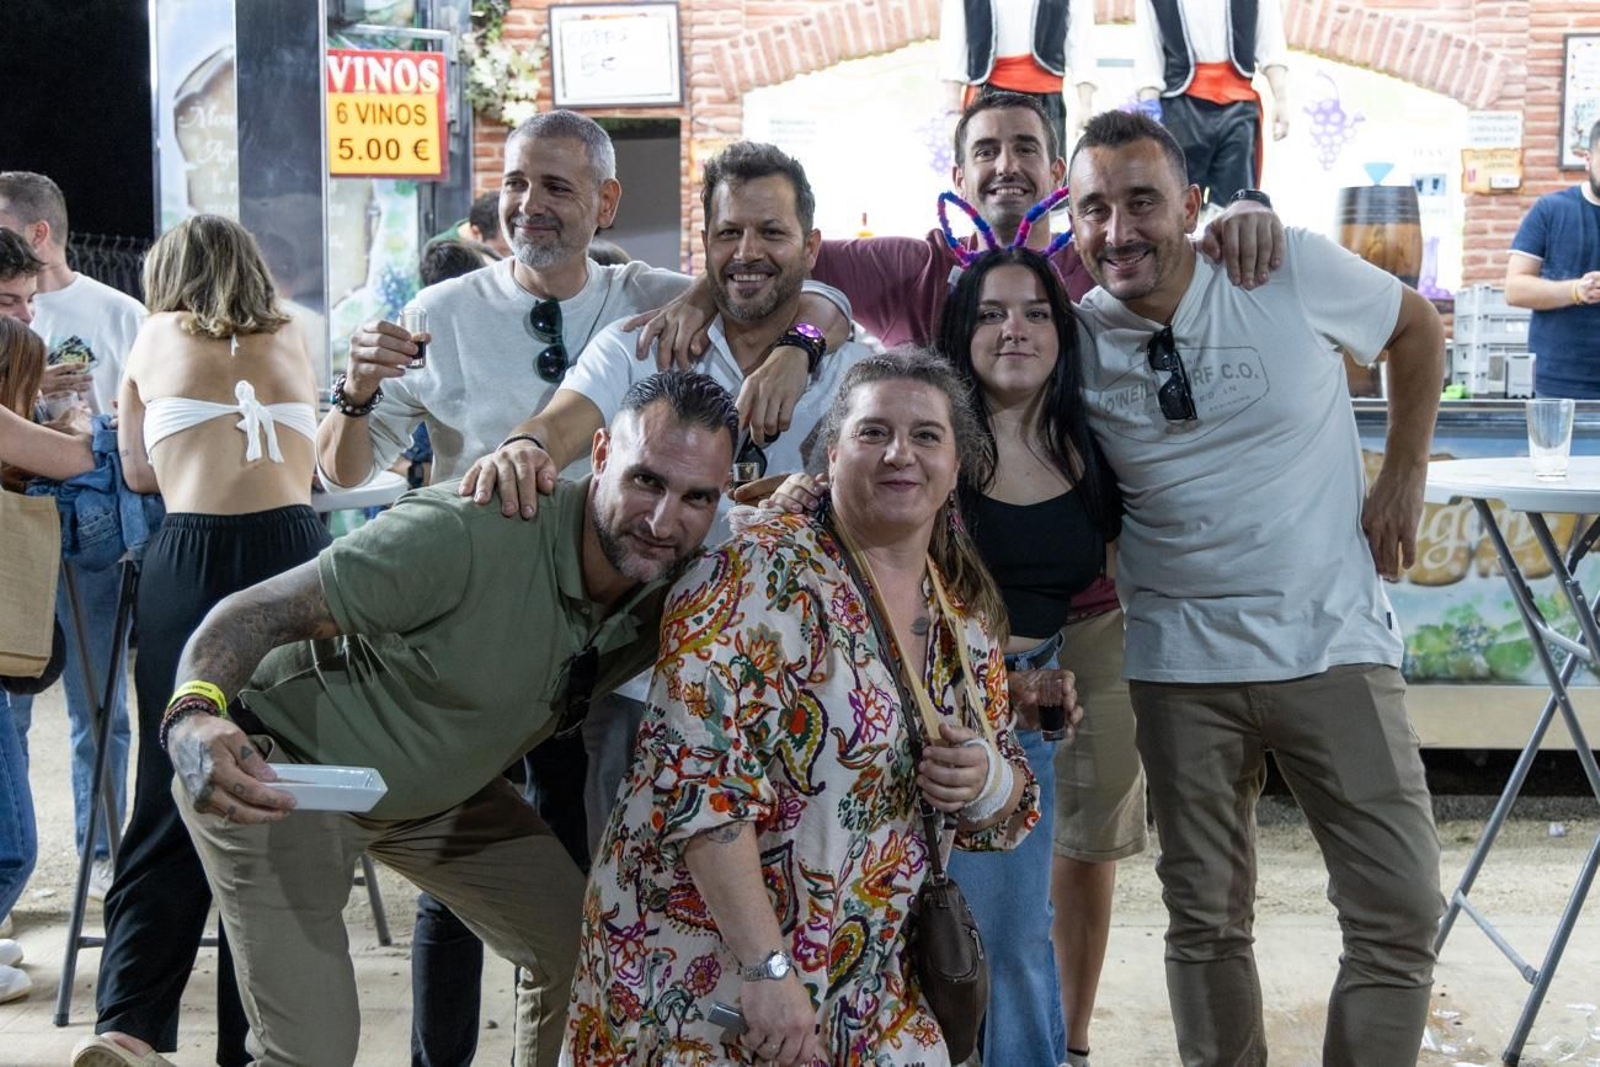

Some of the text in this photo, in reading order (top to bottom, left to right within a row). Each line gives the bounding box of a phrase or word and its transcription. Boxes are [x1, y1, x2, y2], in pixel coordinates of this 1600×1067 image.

[327, 55, 440, 95] VINOS
[337, 102, 427, 126] 6 VINOS
[338, 138, 430, 161] 5.00 €
[1106, 381, 1156, 414] O'NEIL
[1221, 362, 1259, 380] C.O.
